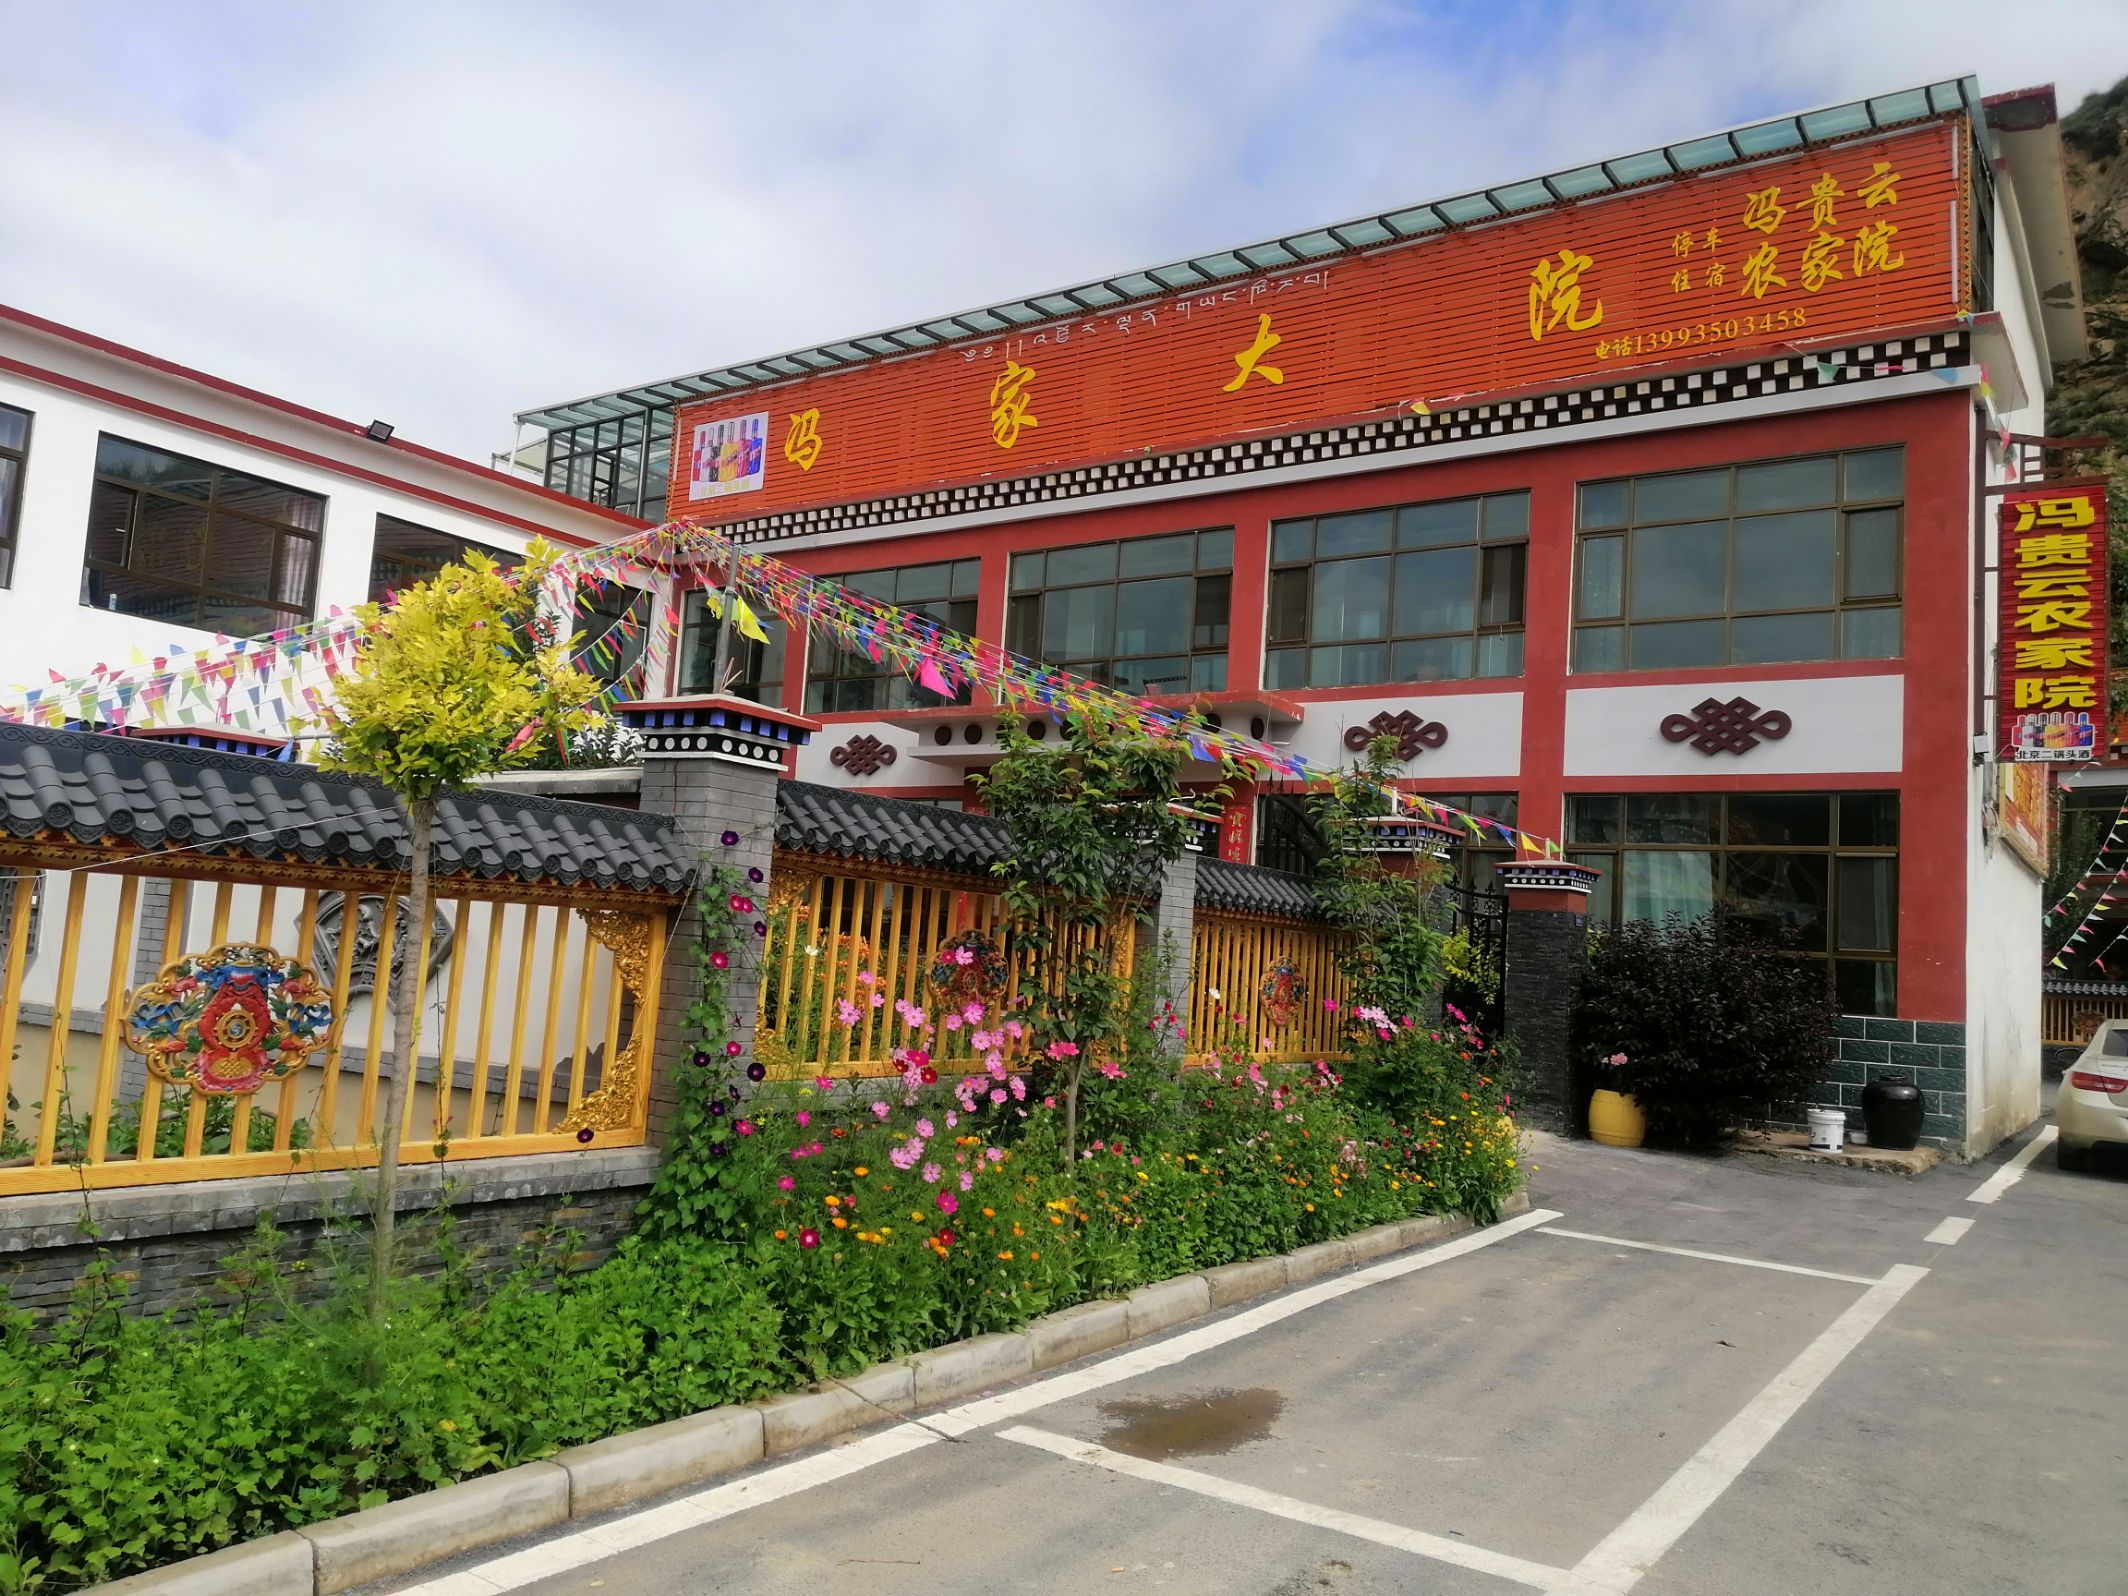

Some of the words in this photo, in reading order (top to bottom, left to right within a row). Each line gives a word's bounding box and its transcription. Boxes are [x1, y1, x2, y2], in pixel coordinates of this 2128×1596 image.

[1743, 161, 1900, 235] 冯贵云
[1671, 226, 1723, 258] 停车
[1740, 220, 1905, 300] 农家院
[1671, 262, 1727, 294] 住宿
[2014, 495, 2097, 710] 冯贵云农家院
[2016, 748, 2091, 760] 北京二锅头酒
